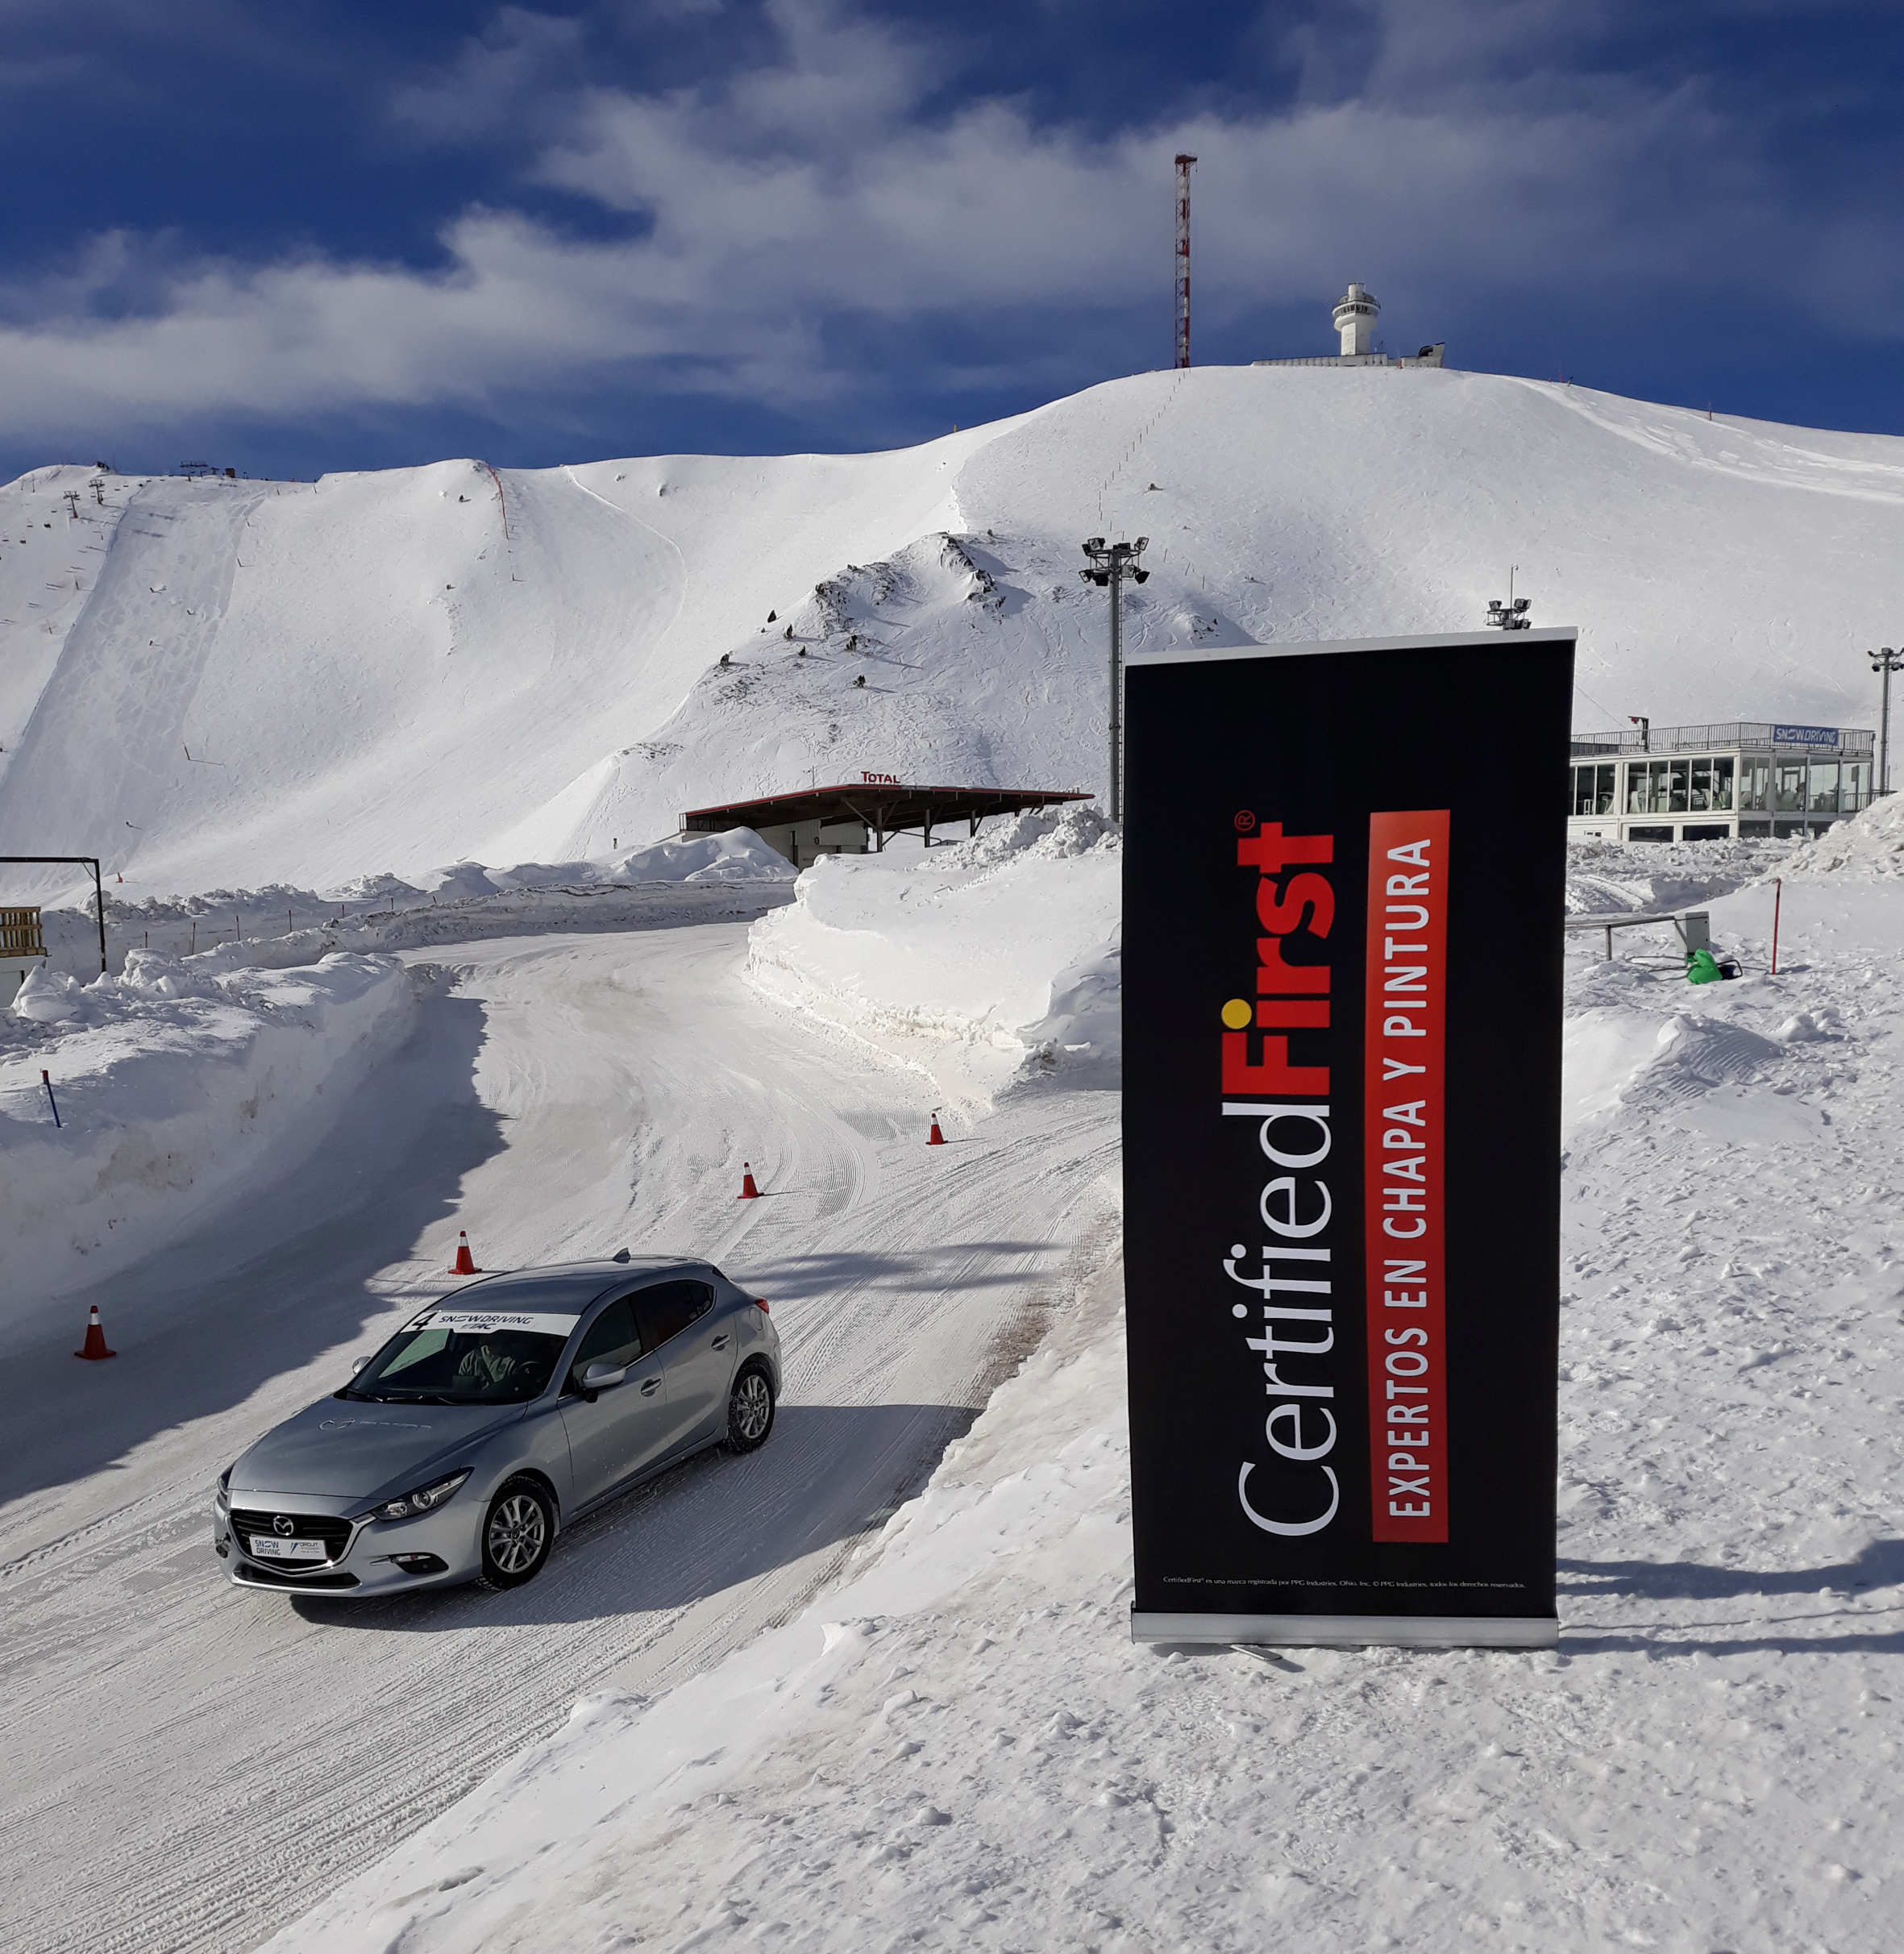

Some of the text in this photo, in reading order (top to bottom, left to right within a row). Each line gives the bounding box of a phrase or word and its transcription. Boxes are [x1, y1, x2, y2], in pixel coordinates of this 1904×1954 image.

[860, 771, 900, 784] TOTAL
[1382, 838, 1431, 1517] EXPERTOS EN CHAPA Y PINTURA
[412, 1312, 438, 1330] 4
[255, 1539, 279, 1549] SNOW
[256, 1547, 281, 1556] DRIVING
[1247, 1578, 1278, 1587] registrada
